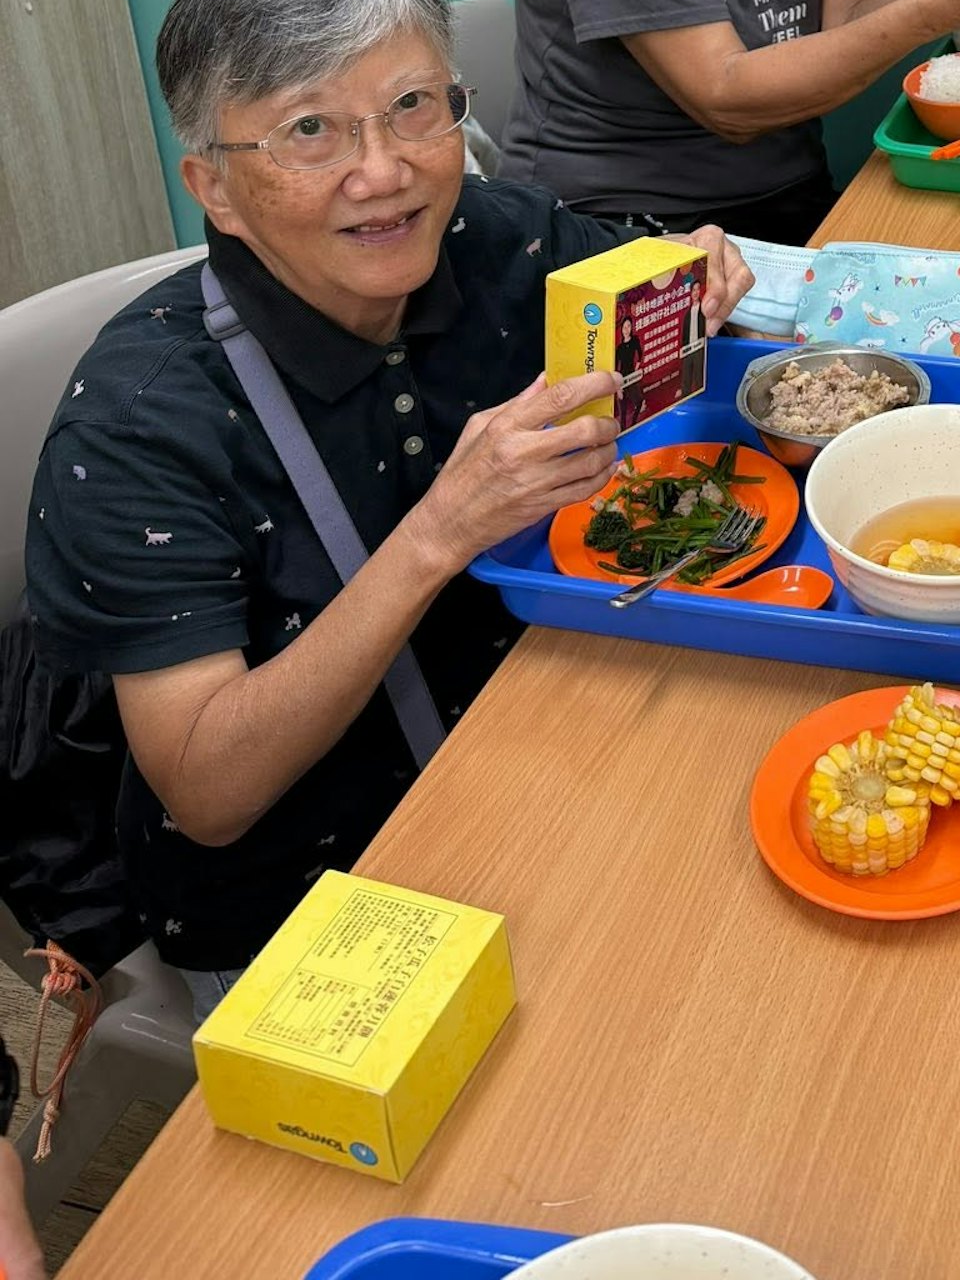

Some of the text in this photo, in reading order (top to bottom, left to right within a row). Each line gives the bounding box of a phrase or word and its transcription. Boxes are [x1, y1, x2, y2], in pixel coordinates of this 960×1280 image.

[758, 3, 808, 32] Them
[585, 329, 597, 374] Townga
[277, 1122, 348, 1154] Towngas
